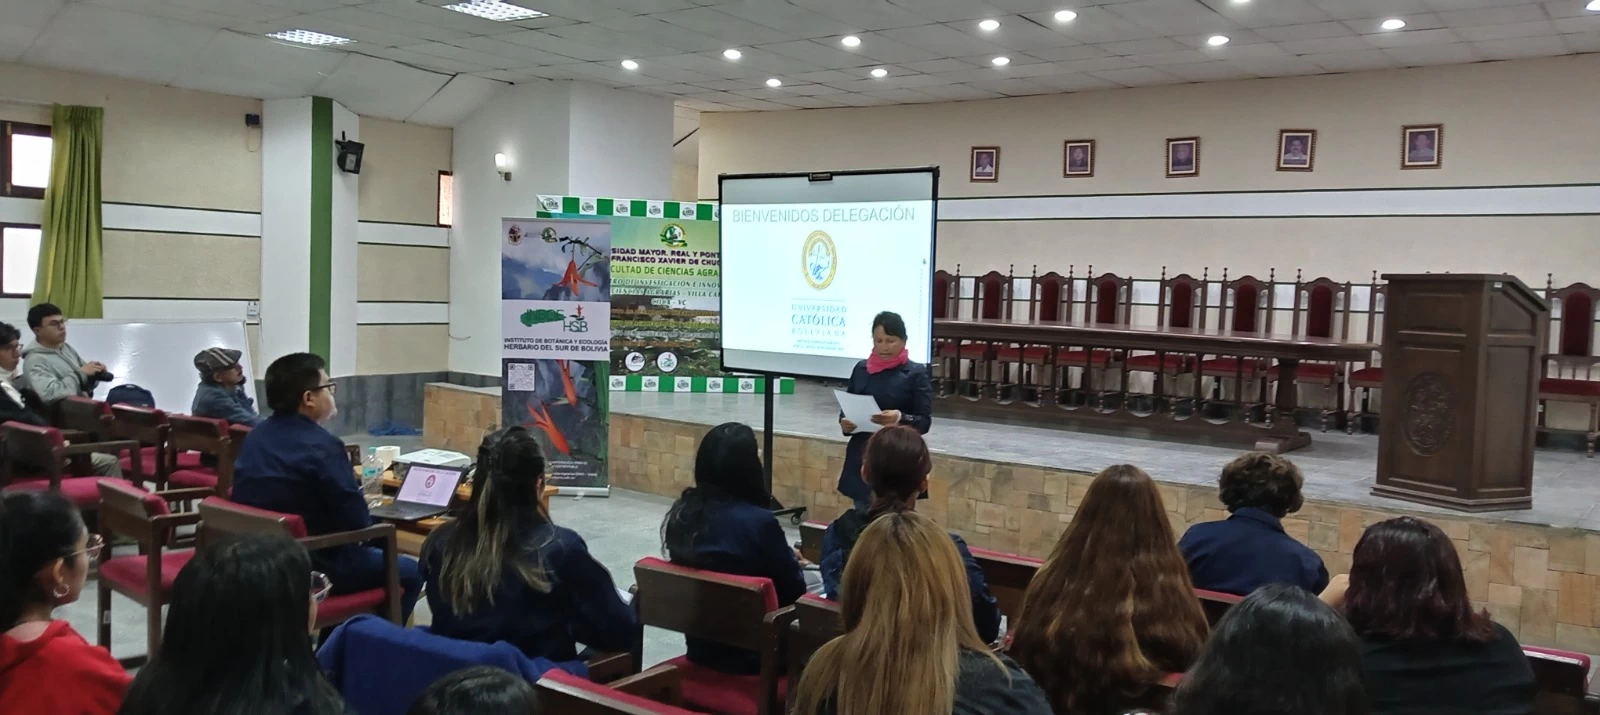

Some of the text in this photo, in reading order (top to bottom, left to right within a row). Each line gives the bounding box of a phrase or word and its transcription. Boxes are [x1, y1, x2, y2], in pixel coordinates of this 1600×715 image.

[733, 209, 819, 223] BIENVENIDOS
[823, 205, 915, 222] DELEGACIÓN
[658, 257, 686, 265] XAVIER
[611, 265, 718, 277] CULTAD DE CIENCIAS AGRA
[635, 279, 690, 287] INVESTIGACIÓN
[645, 287, 680, 296] AGRARIAS
[792, 312, 846, 327] CATÓLICA
[563, 320, 588, 332] HSB
